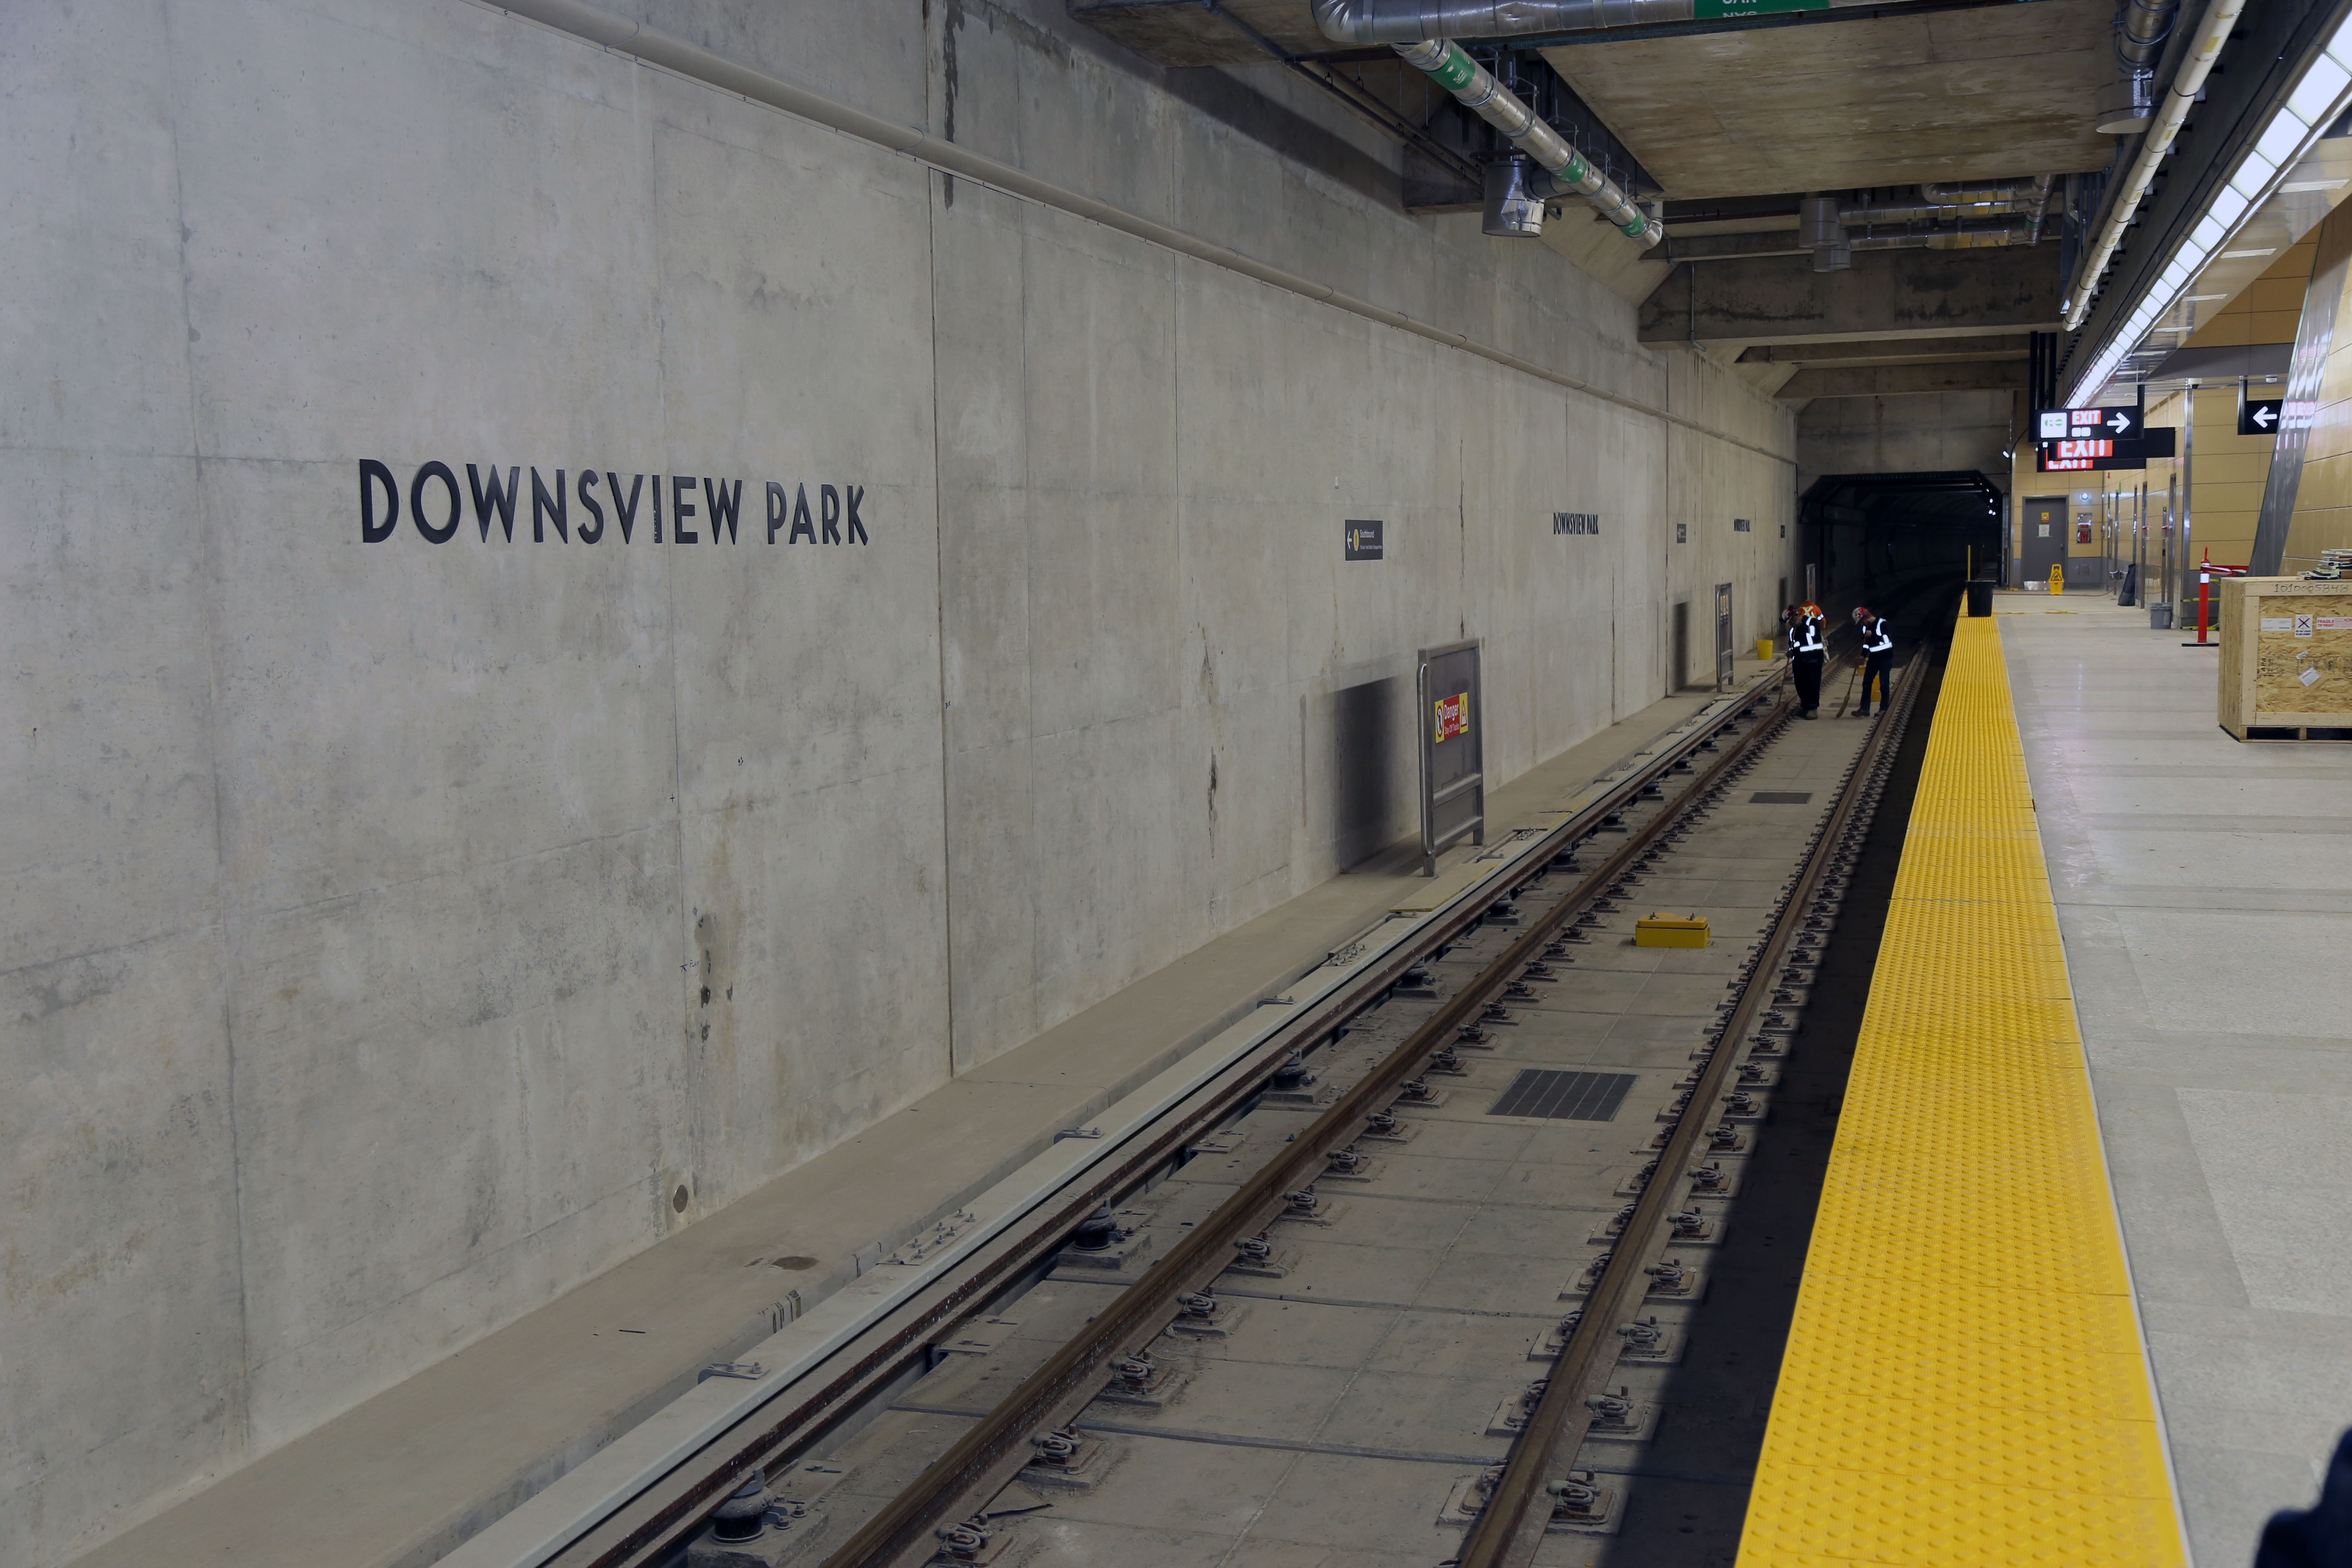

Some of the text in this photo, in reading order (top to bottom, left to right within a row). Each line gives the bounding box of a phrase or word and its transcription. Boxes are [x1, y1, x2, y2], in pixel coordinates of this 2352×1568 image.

[2072, 410, 2100, 425] EXIT
[359, 458, 869, 546] DOWNSVIEW PARK
[1553, 512, 1599, 535] DOWNSVIEW PARK
[1444, 704, 1459, 721] Danger
